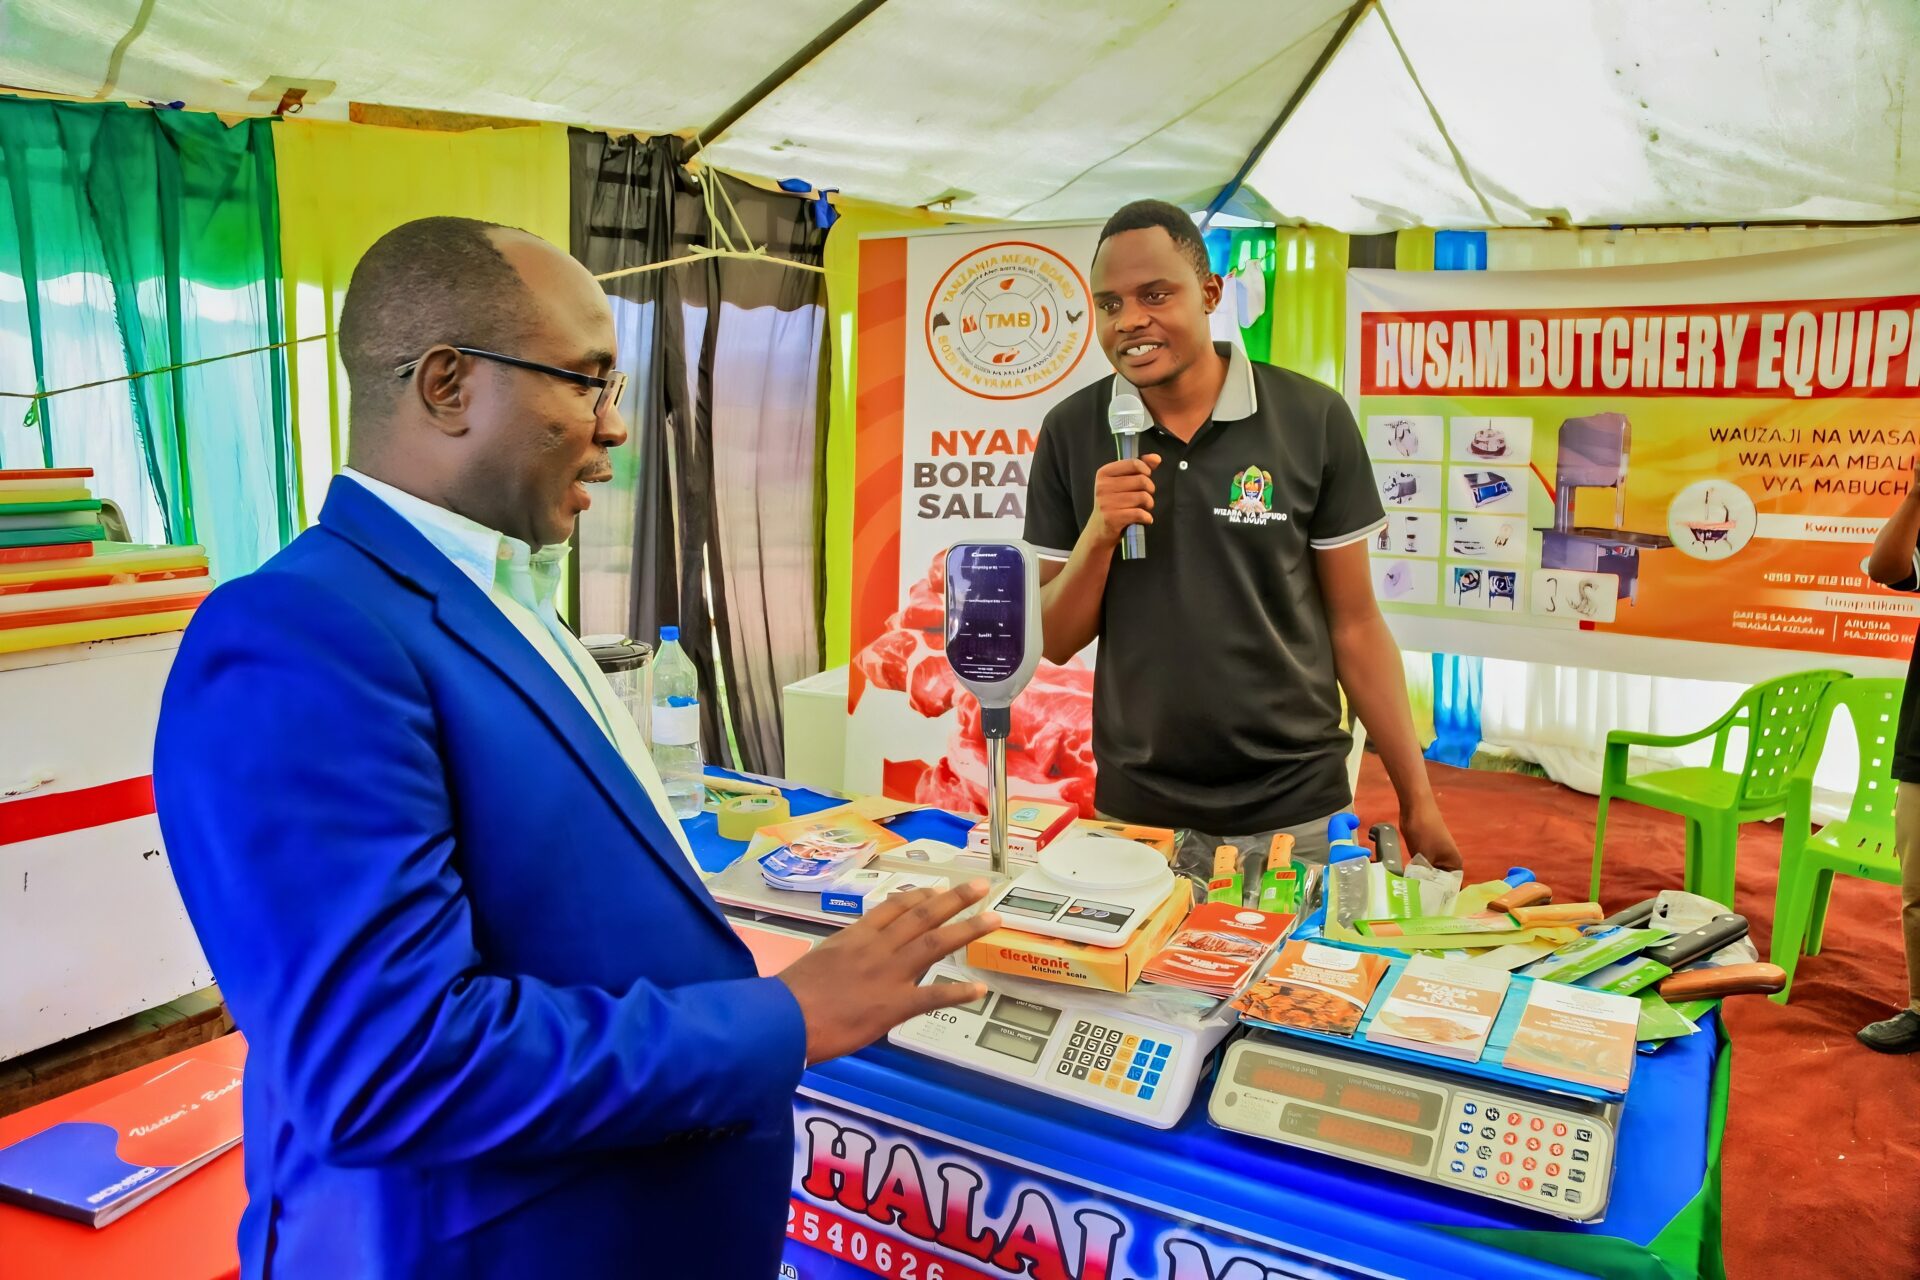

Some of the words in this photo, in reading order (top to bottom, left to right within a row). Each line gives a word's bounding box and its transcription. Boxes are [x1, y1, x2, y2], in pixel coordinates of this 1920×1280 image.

[943, 257, 998, 302] TANZANIA
[1001, 254, 1039, 265] MEAT
[1039, 262, 1075, 299] BOARD
[985, 312, 1031, 330] TMB
[1025, 332, 1078, 384] TANZANIA
[1375, 320, 1509, 389] HUSAM
[1519, 314, 1749, 389] BUTCHERY
[1710, 427, 1801, 443] WAUZAJI
[1812, 428, 1842, 444] NA
[1849, 429, 1920, 445] WASA
[1739, 452, 1772, 468] WA
[1779, 453, 1840, 469] VIFAA
[1847, 455, 1915, 471] MBALI
[914, 461, 1028, 488] BORA
[1762, 476, 1803, 492] VYA
[1814, 479, 1909, 496] MABUCH
[917, 492, 1025, 519] SALA
[1000, 948, 1070, 970] Electronic
[1031, 965, 1062, 976] Kitchen
[1066, 971, 1088, 980] scale
[1079, 1023, 1088, 1032] 7
[1096, 1028, 1104, 1037] 8
[1110, 1032, 1120, 1041] 9
[1071, 1036, 1080, 1046] 4
[1087, 1041, 1097, 1050] 5
[1103, 1045, 1112, 1055] 6
[1059, 1062, 1070, 1073] 0
[1067, 1049, 1075, 1059] 1
[1081, 1054, 1091, 1064] 2
[1097, 1059, 1108, 1069] 3
